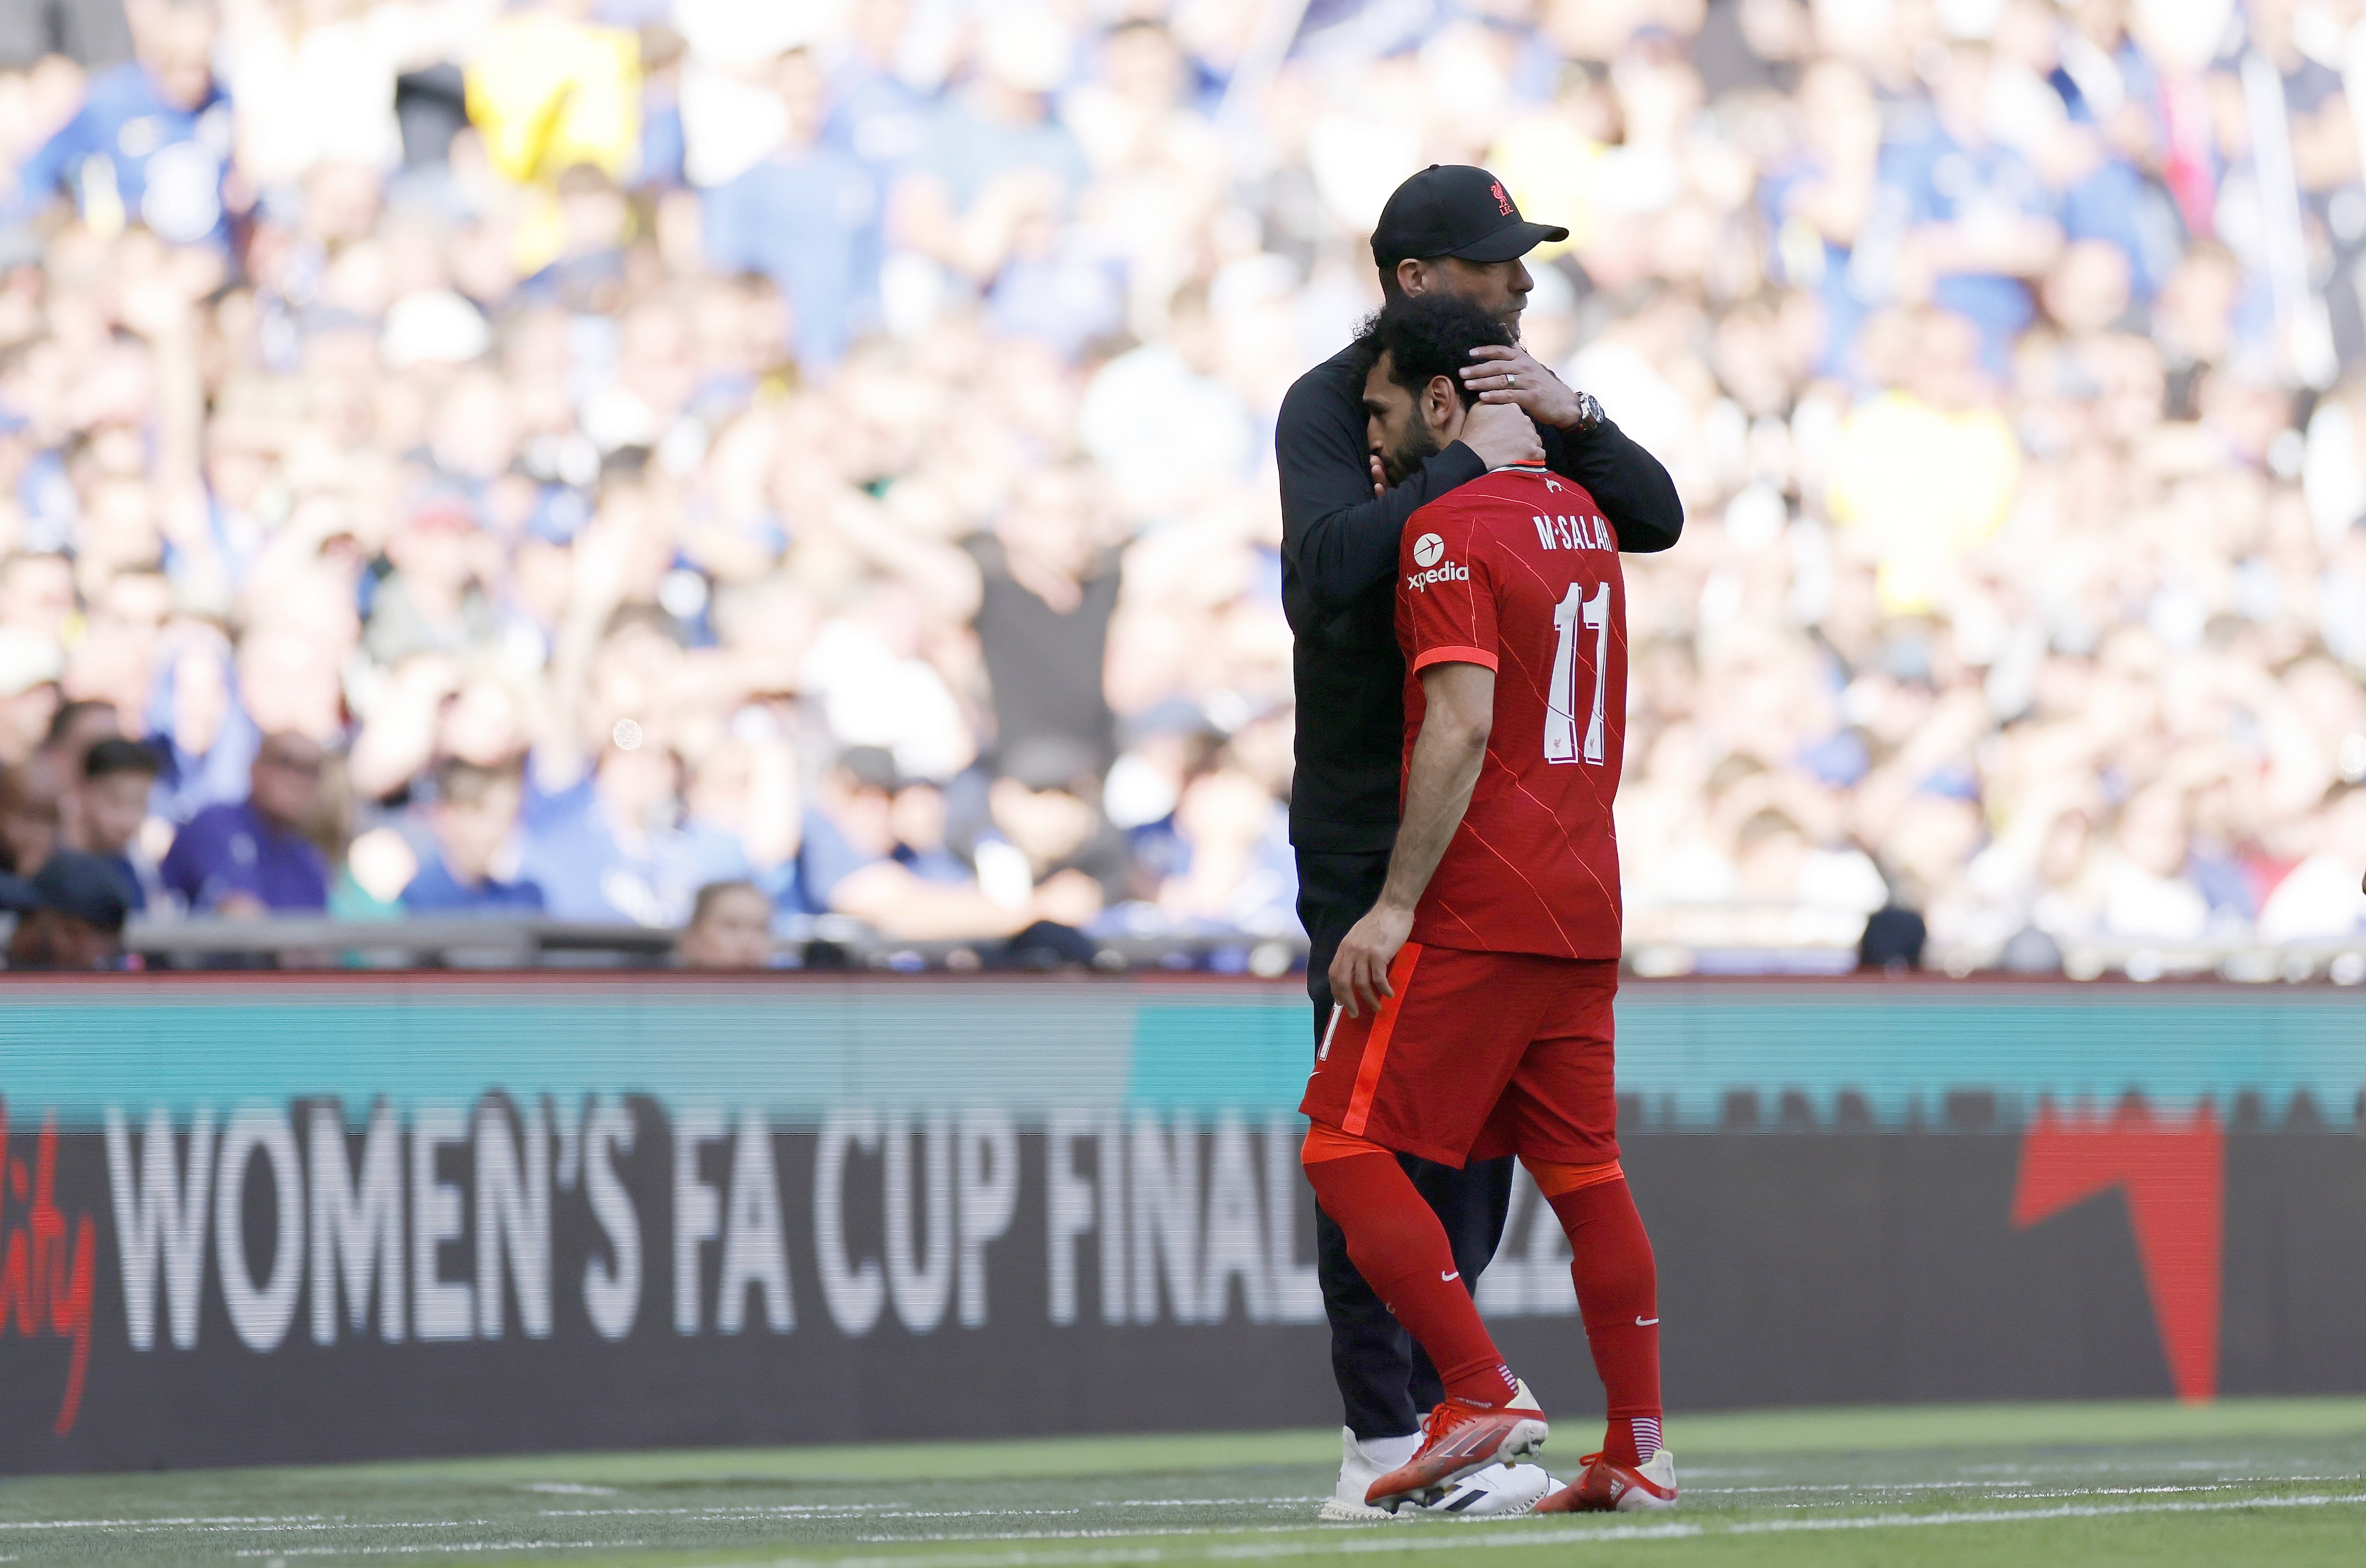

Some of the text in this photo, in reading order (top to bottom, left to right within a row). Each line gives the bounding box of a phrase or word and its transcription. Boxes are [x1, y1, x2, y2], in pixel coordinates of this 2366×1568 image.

[1407, 560, 1469, 593] xpedia
[1545, 582, 1611, 766] 11
[0, 1094, 95, 1436] ity
[104, 1103, 644, 1354] WOMEN'S
[671, 1107, 798, 1337] FA
[812, 1107, 1021, 1338] CUP
[1044, 1106, 1326, 1326] FINAL
